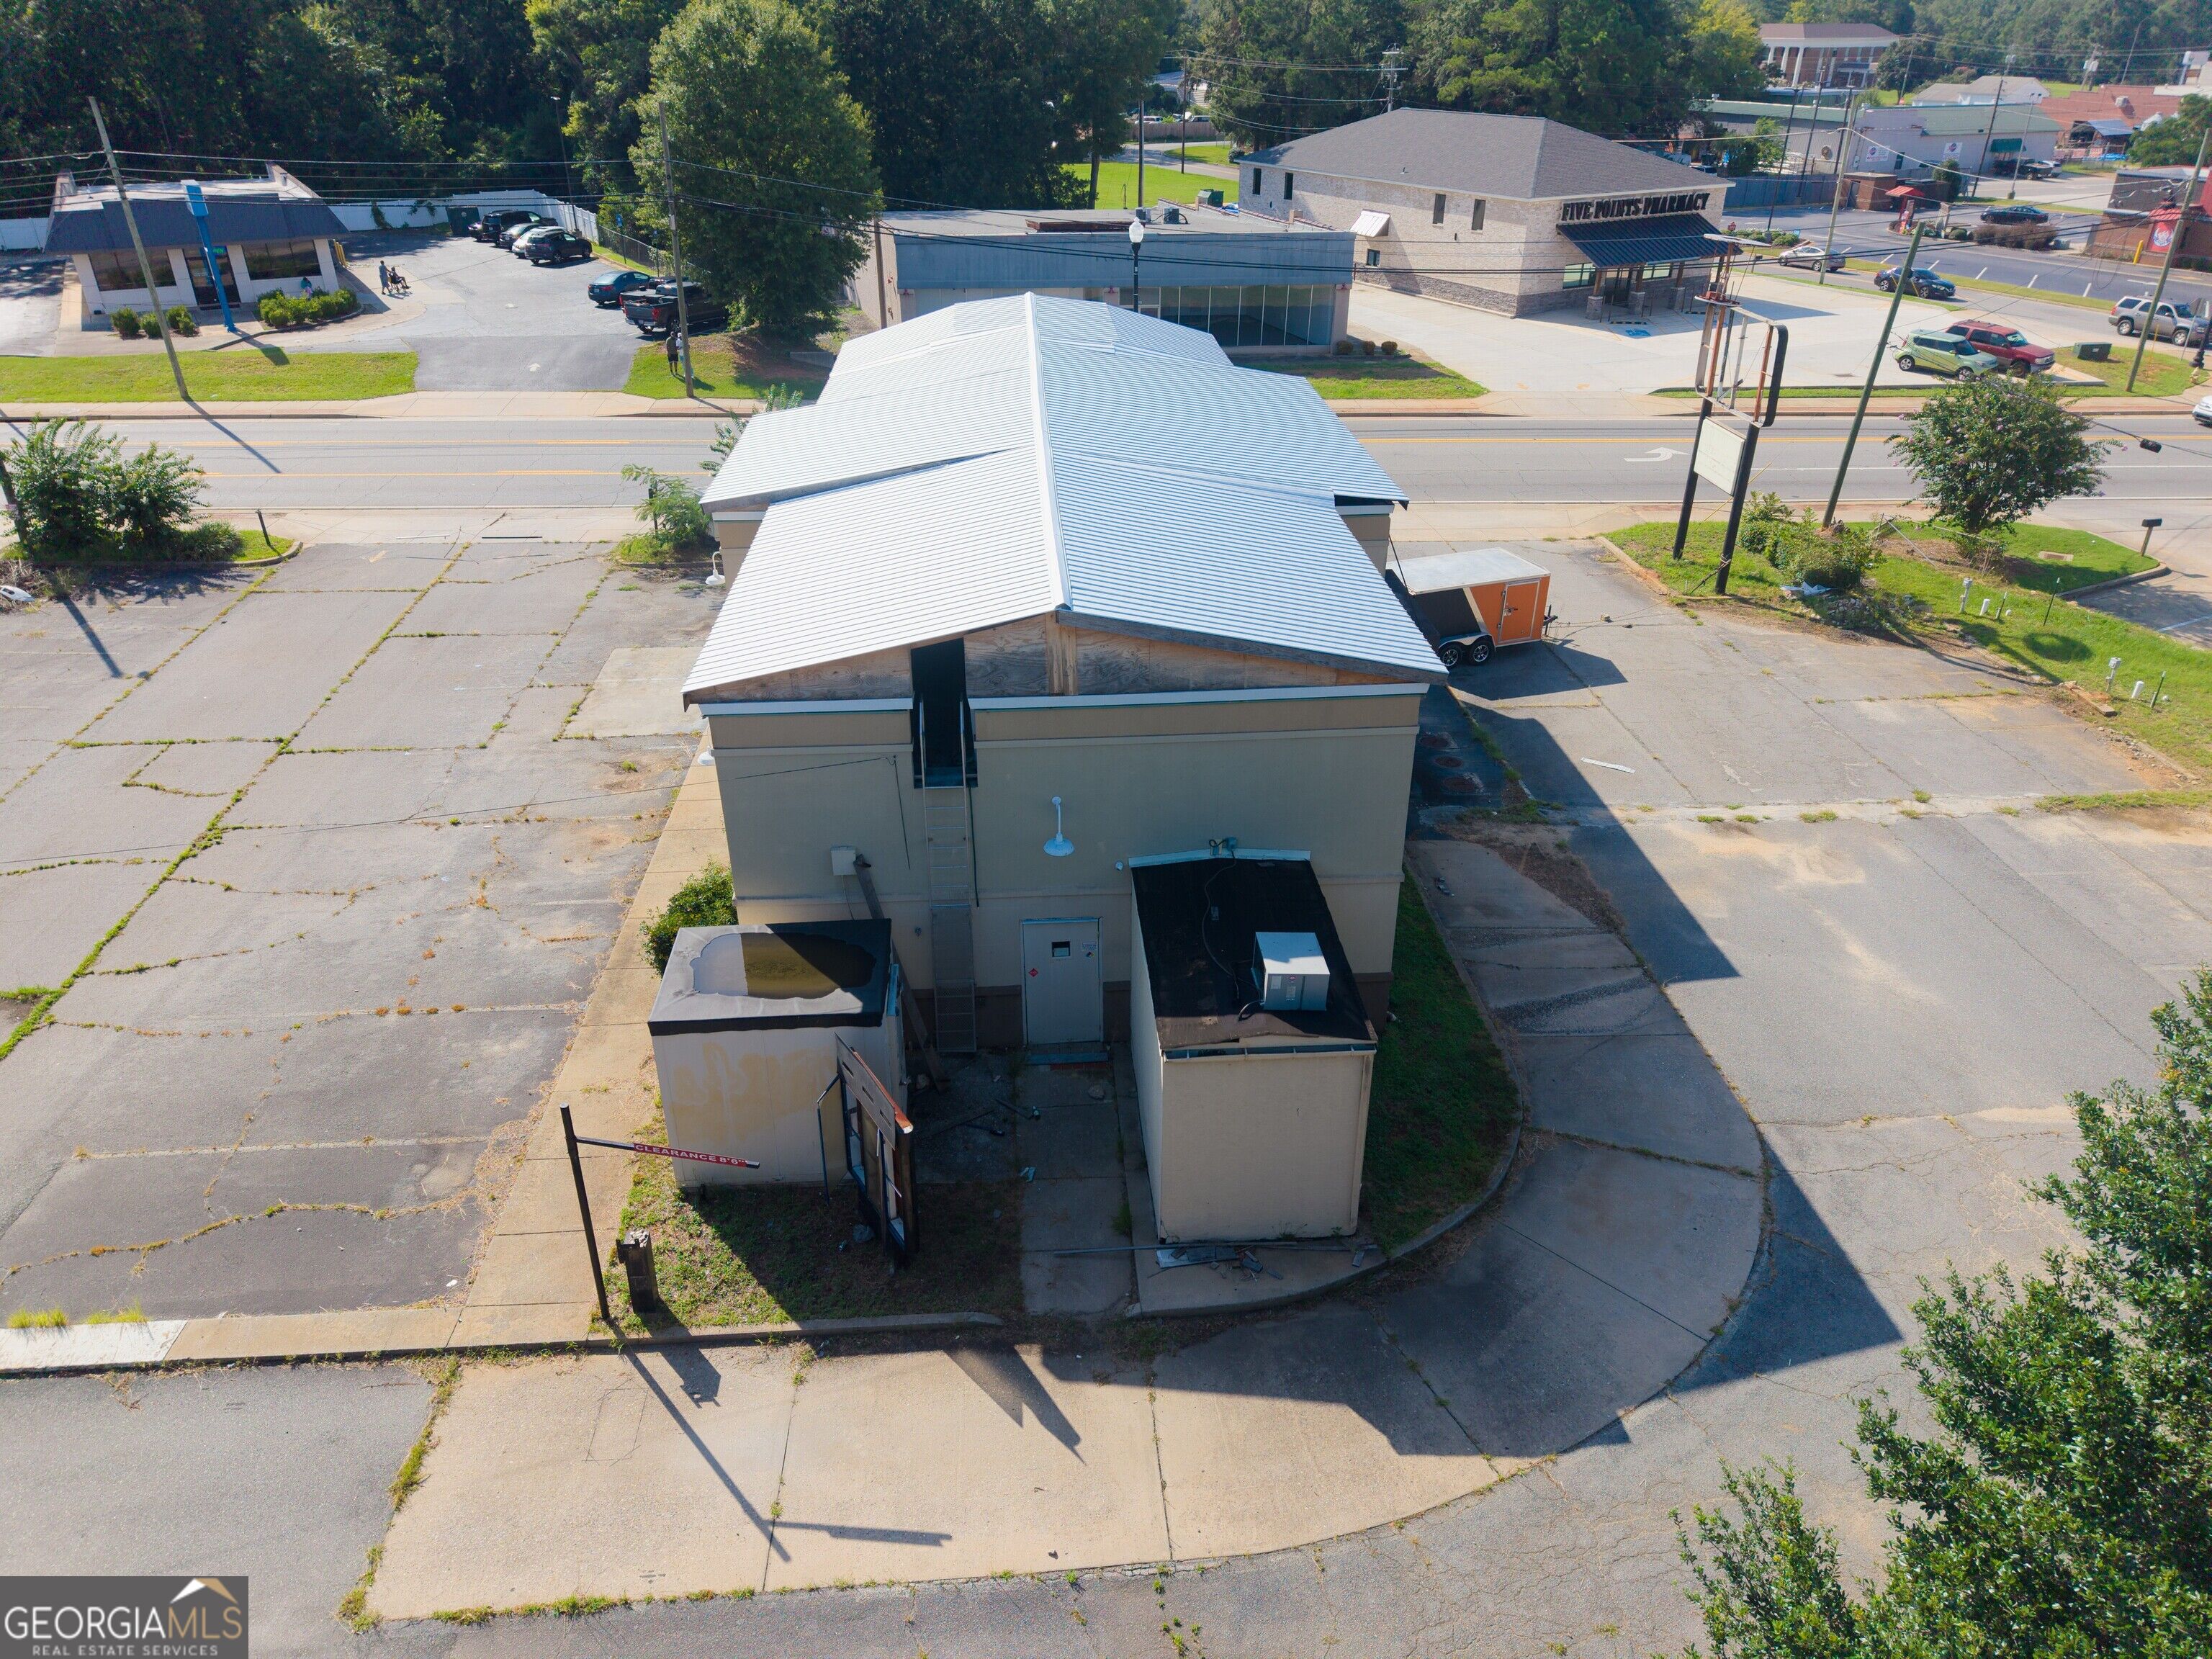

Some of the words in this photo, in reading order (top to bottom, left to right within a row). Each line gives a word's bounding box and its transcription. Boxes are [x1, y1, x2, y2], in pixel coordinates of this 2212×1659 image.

[1561, 201, 1593, 221] FIVE
[1593, 198, 1642, 219] POINTS
[1642, 192, 1710, 215] PHARMACY
[635, 1144, 717, 1161] CLEARANCE
